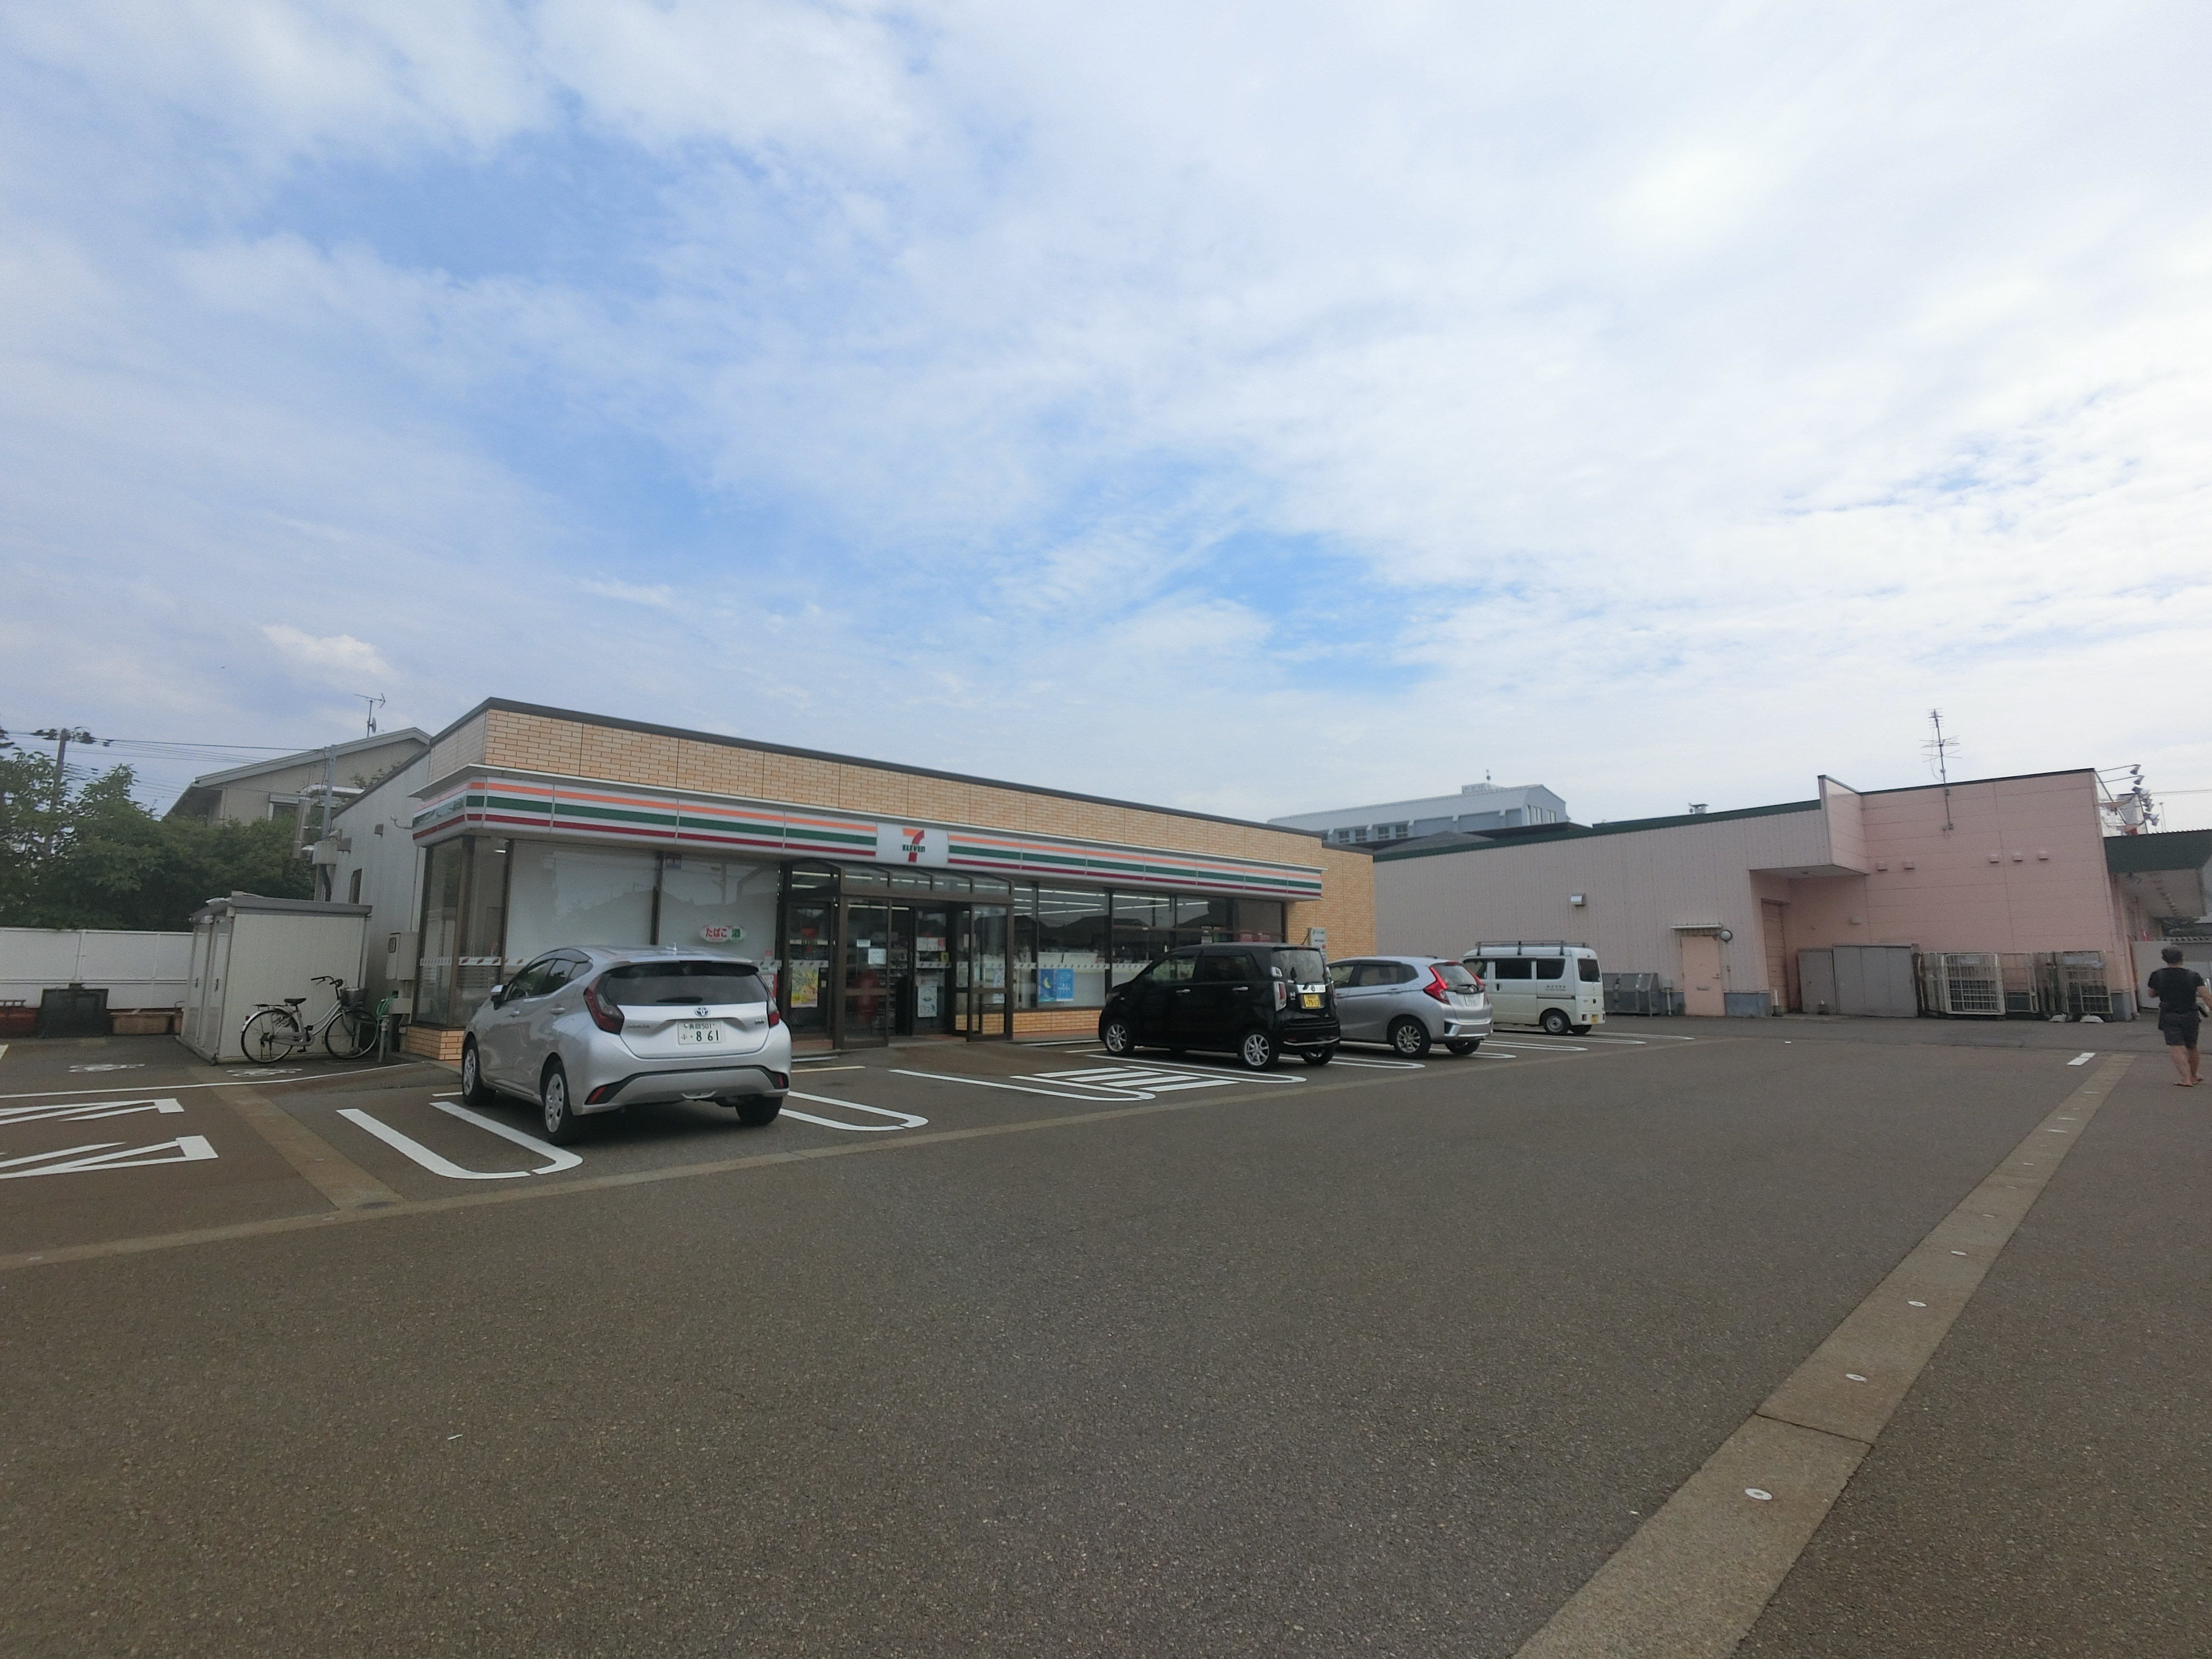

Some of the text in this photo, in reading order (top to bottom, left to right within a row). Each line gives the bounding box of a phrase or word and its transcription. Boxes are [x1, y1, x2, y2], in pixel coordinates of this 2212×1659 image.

[706, 927, 741, 938] たばこ 酒
